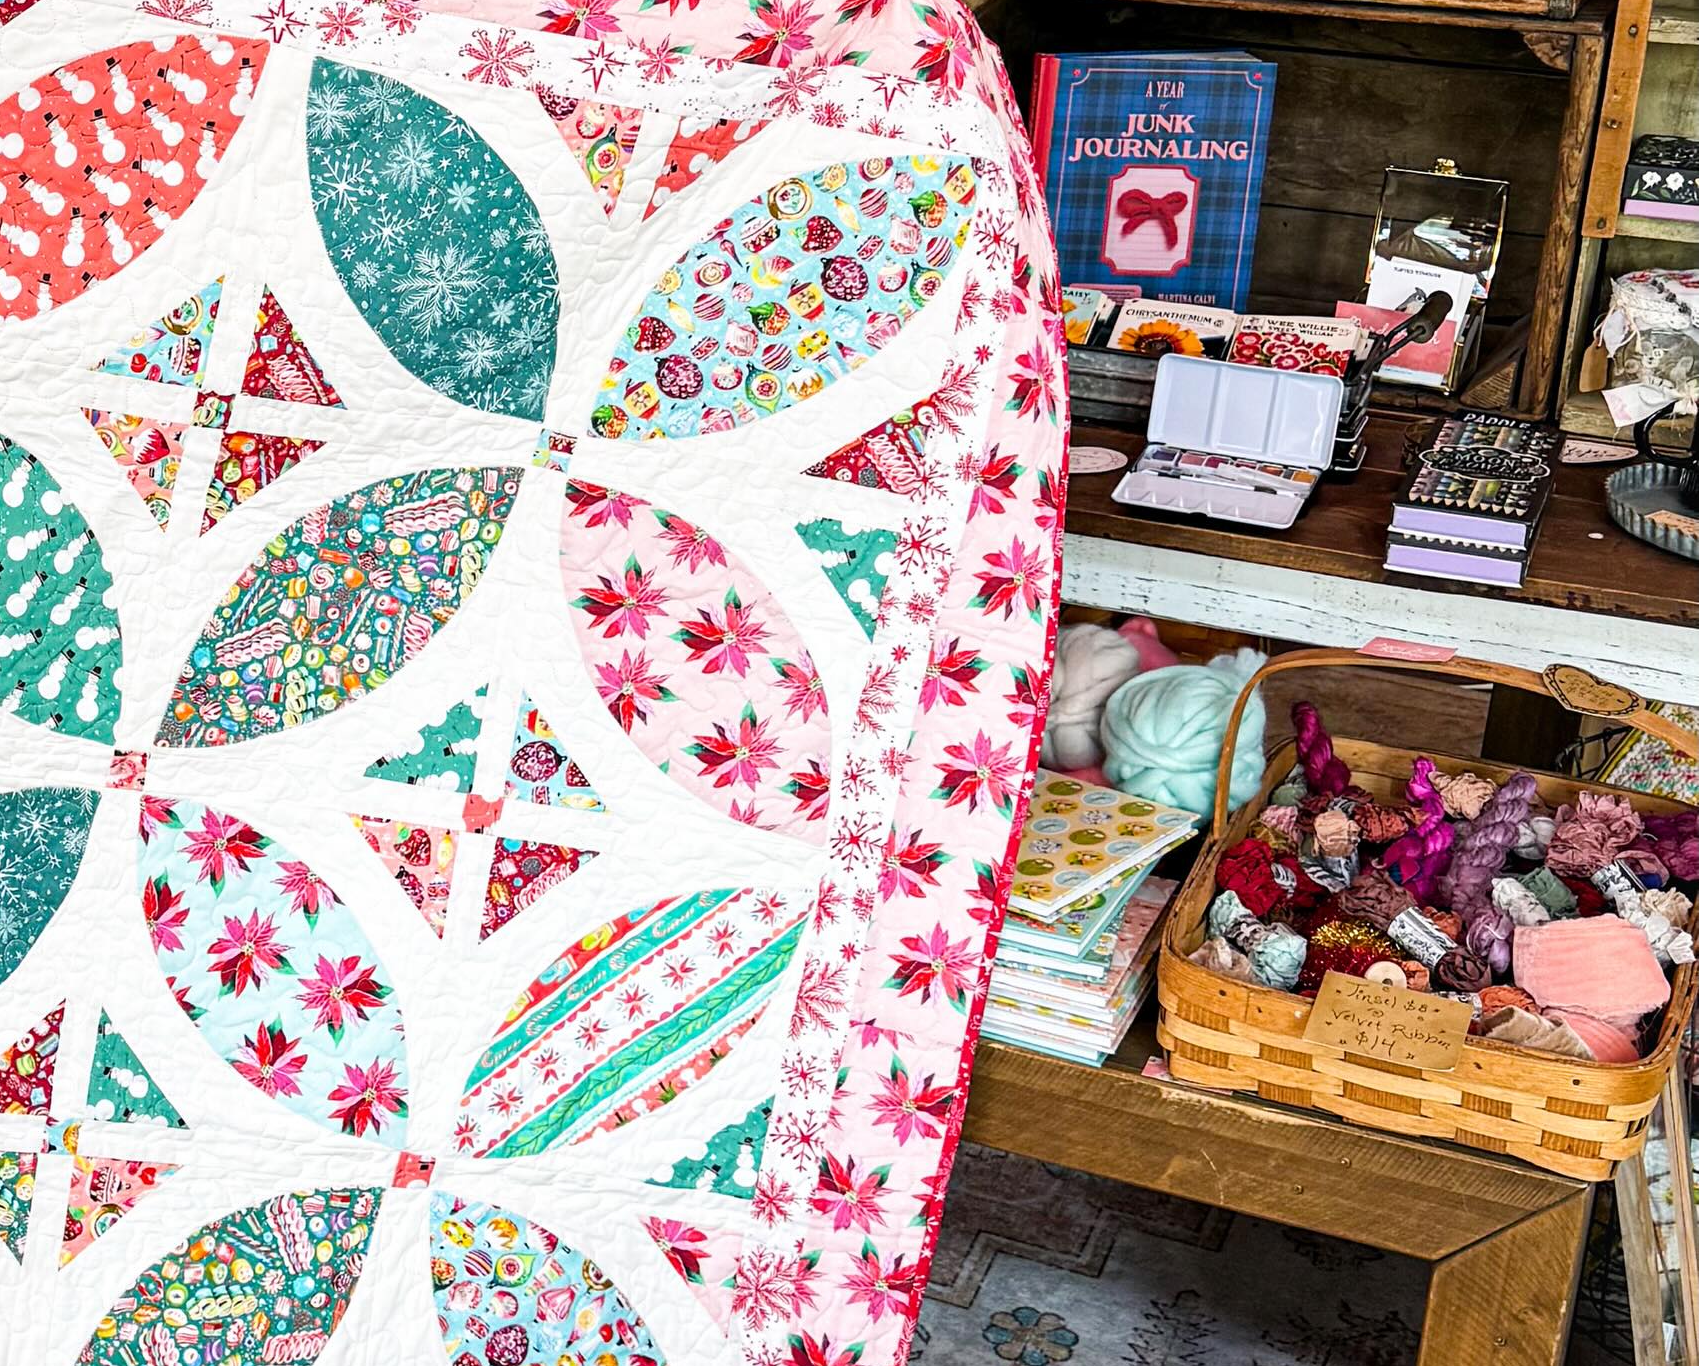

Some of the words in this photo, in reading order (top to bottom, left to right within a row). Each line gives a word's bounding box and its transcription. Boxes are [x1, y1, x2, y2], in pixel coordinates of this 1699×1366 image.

[1145, 80, 1153, 98] A
[1156, 80, 1185, 100] YEAR
[1120, 113, 1196, 138] JUNK
[1068, 137, 1250, 163] JOURNALING
[1157, 293, 1192, 304] MARTINA
[1125, 308, 1213, 325] CHRYSANTHEMUM
[1267, 319, 1295, 328] WEE
[1298, 322, 1340, 333] WILLIE
[1268, 325, 1296, 333] SWEET
[1299, 329, 1334, 337] WILLIAM
[1455, 452, 1516, 469] MOON
[1346, 980, 1397, 1009] Tinsel
[1331, 1008, 1383, 1032] Velvet
[1355, 1030, 1396, 1058] $14
